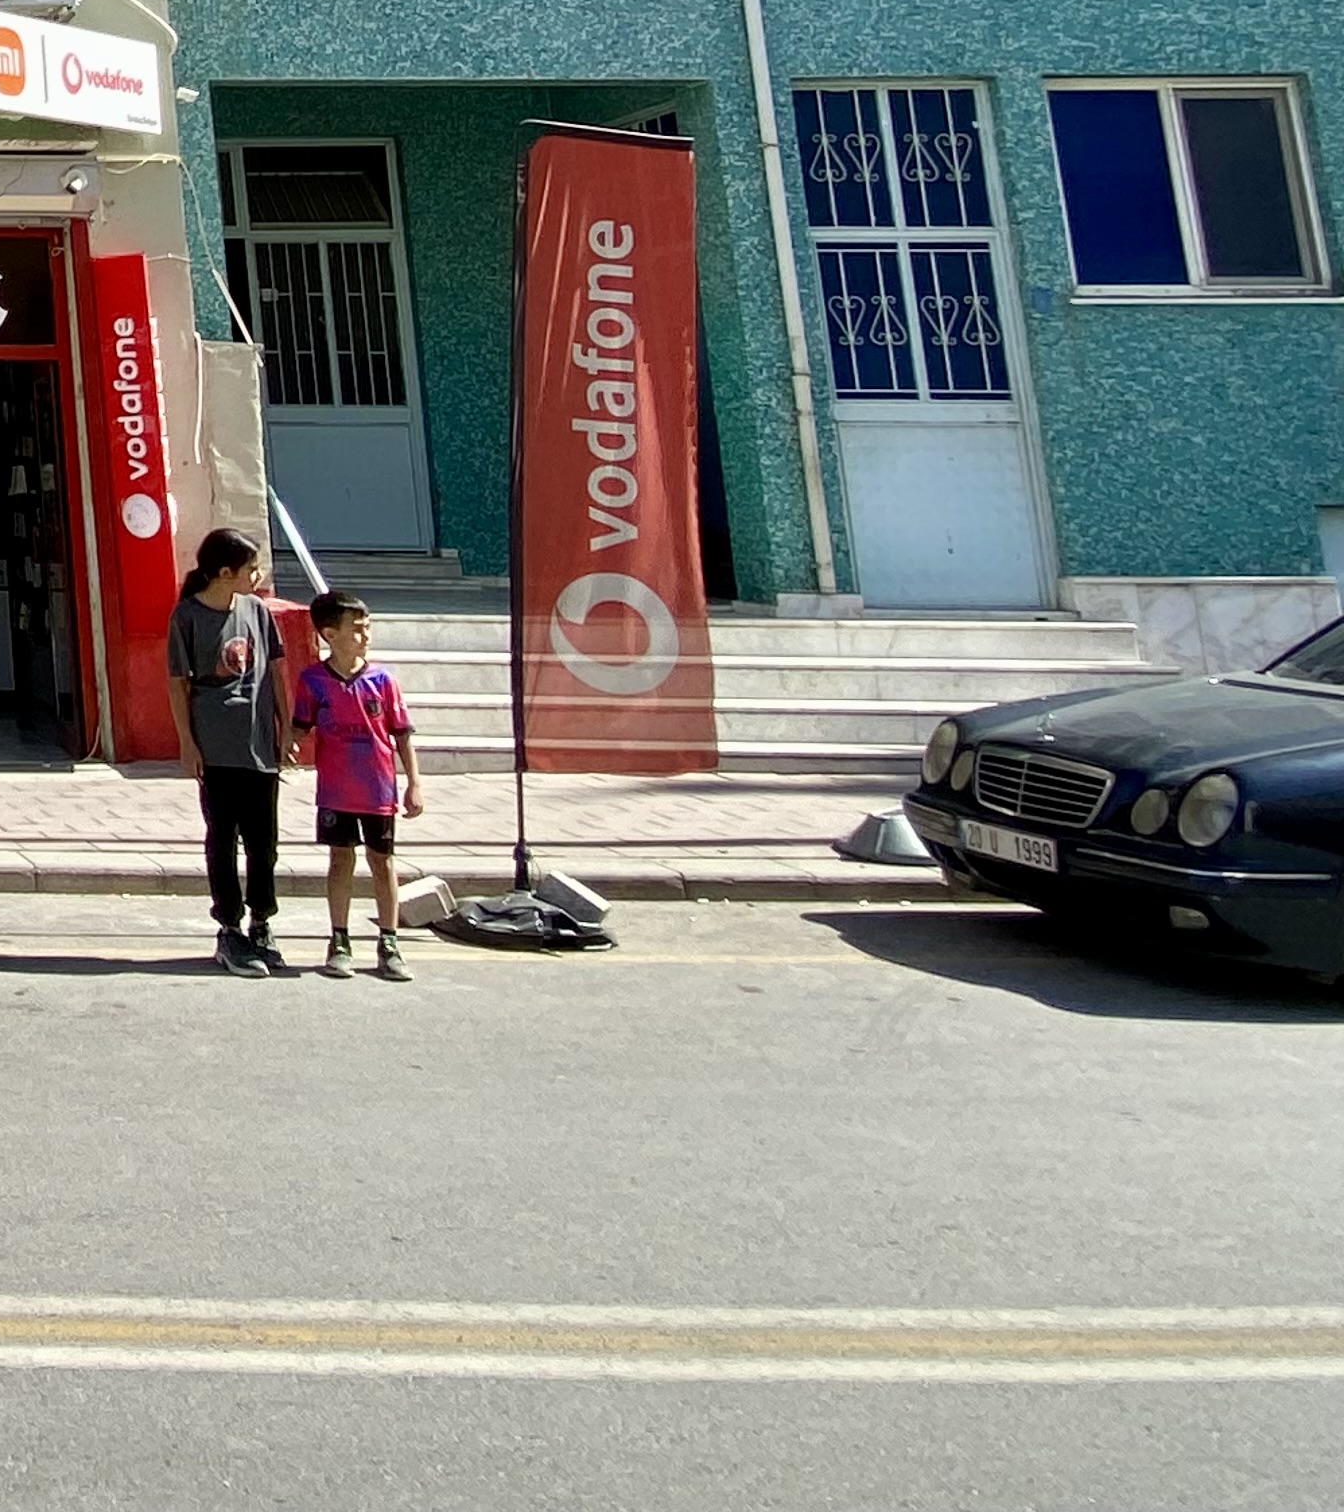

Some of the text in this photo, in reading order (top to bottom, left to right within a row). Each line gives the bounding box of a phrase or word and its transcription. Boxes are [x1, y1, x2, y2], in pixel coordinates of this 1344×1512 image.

[85, 68, 143, 96] vodafone
[113, 317, 148, 480] vodafone
[572, 219, 638, 552] vodafone
[1015, 836, 1052, 867] 1999
